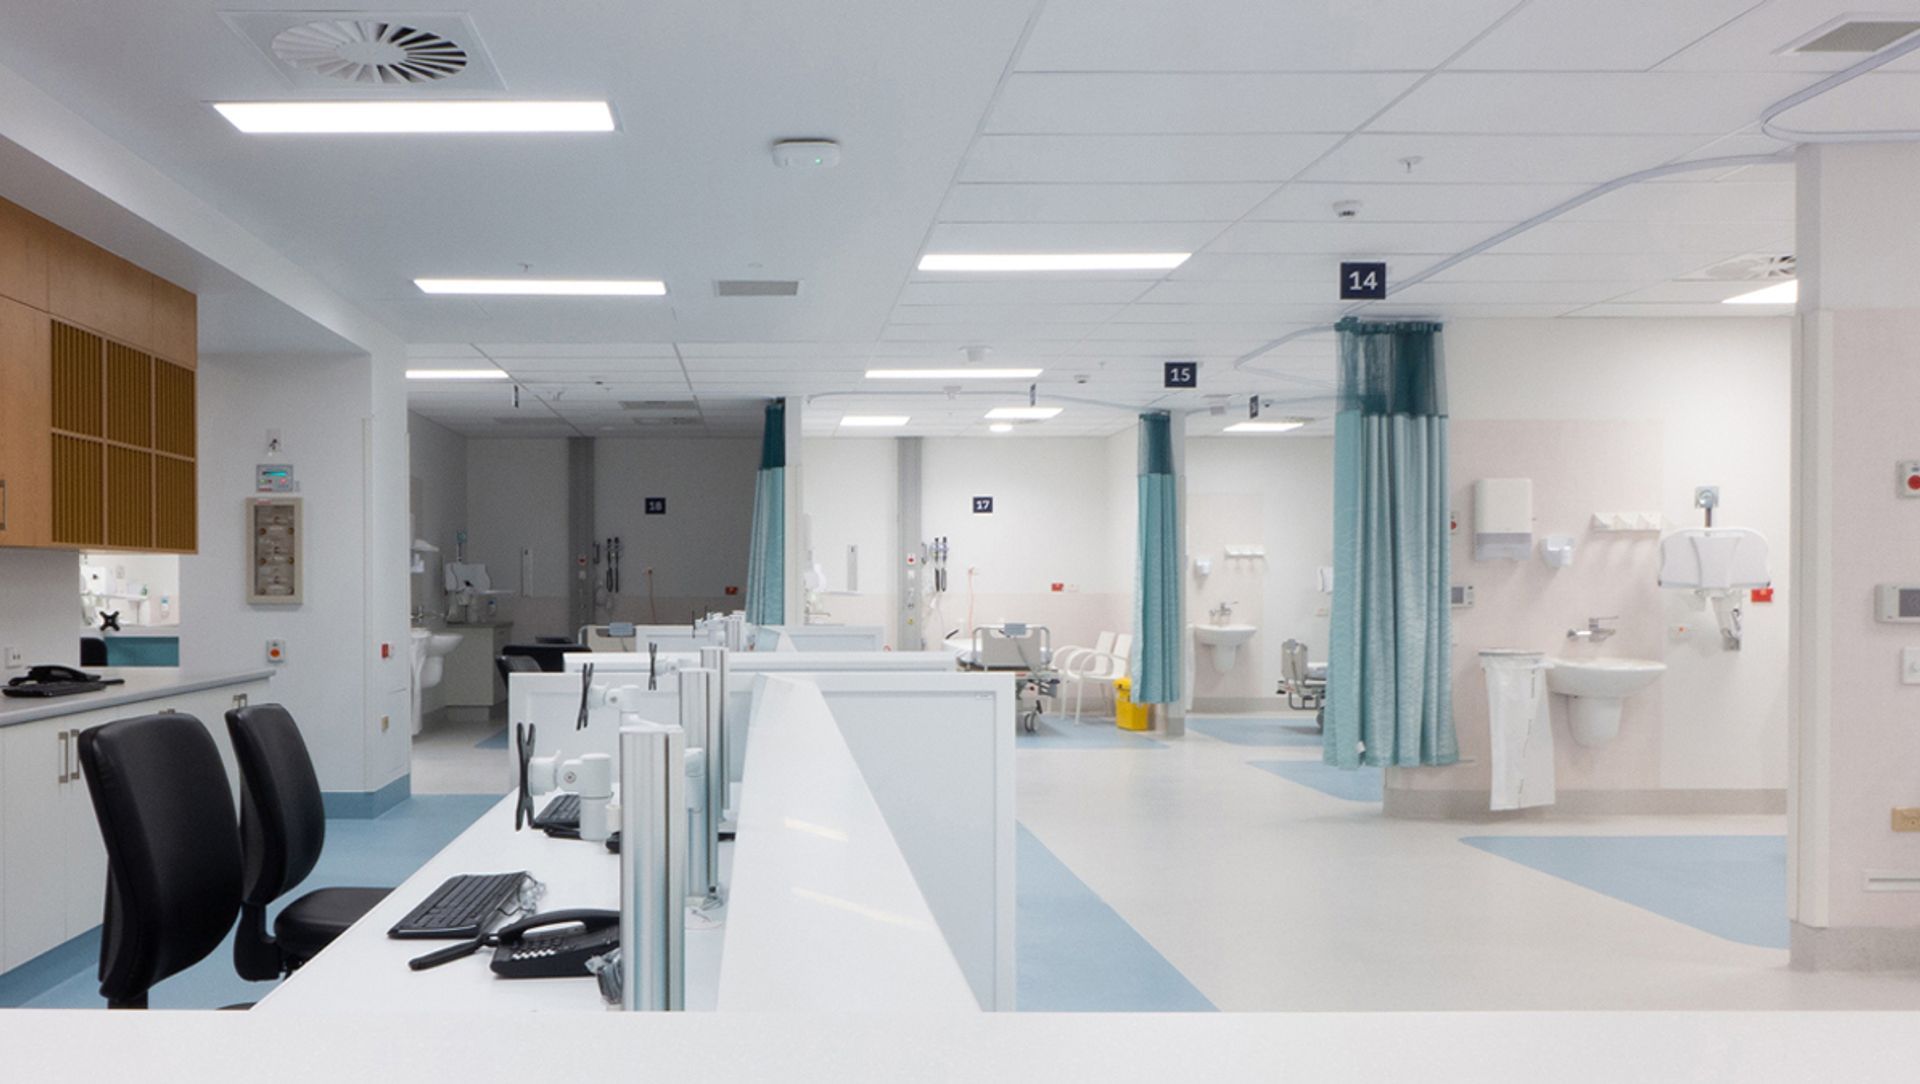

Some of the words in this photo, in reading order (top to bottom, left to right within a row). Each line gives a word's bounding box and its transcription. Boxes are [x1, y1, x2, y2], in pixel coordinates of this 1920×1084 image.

[1349, 271, 1378, 290] 14
[1170, 368, 1191, 382] 15
[976, 500, 990, 510] 17
